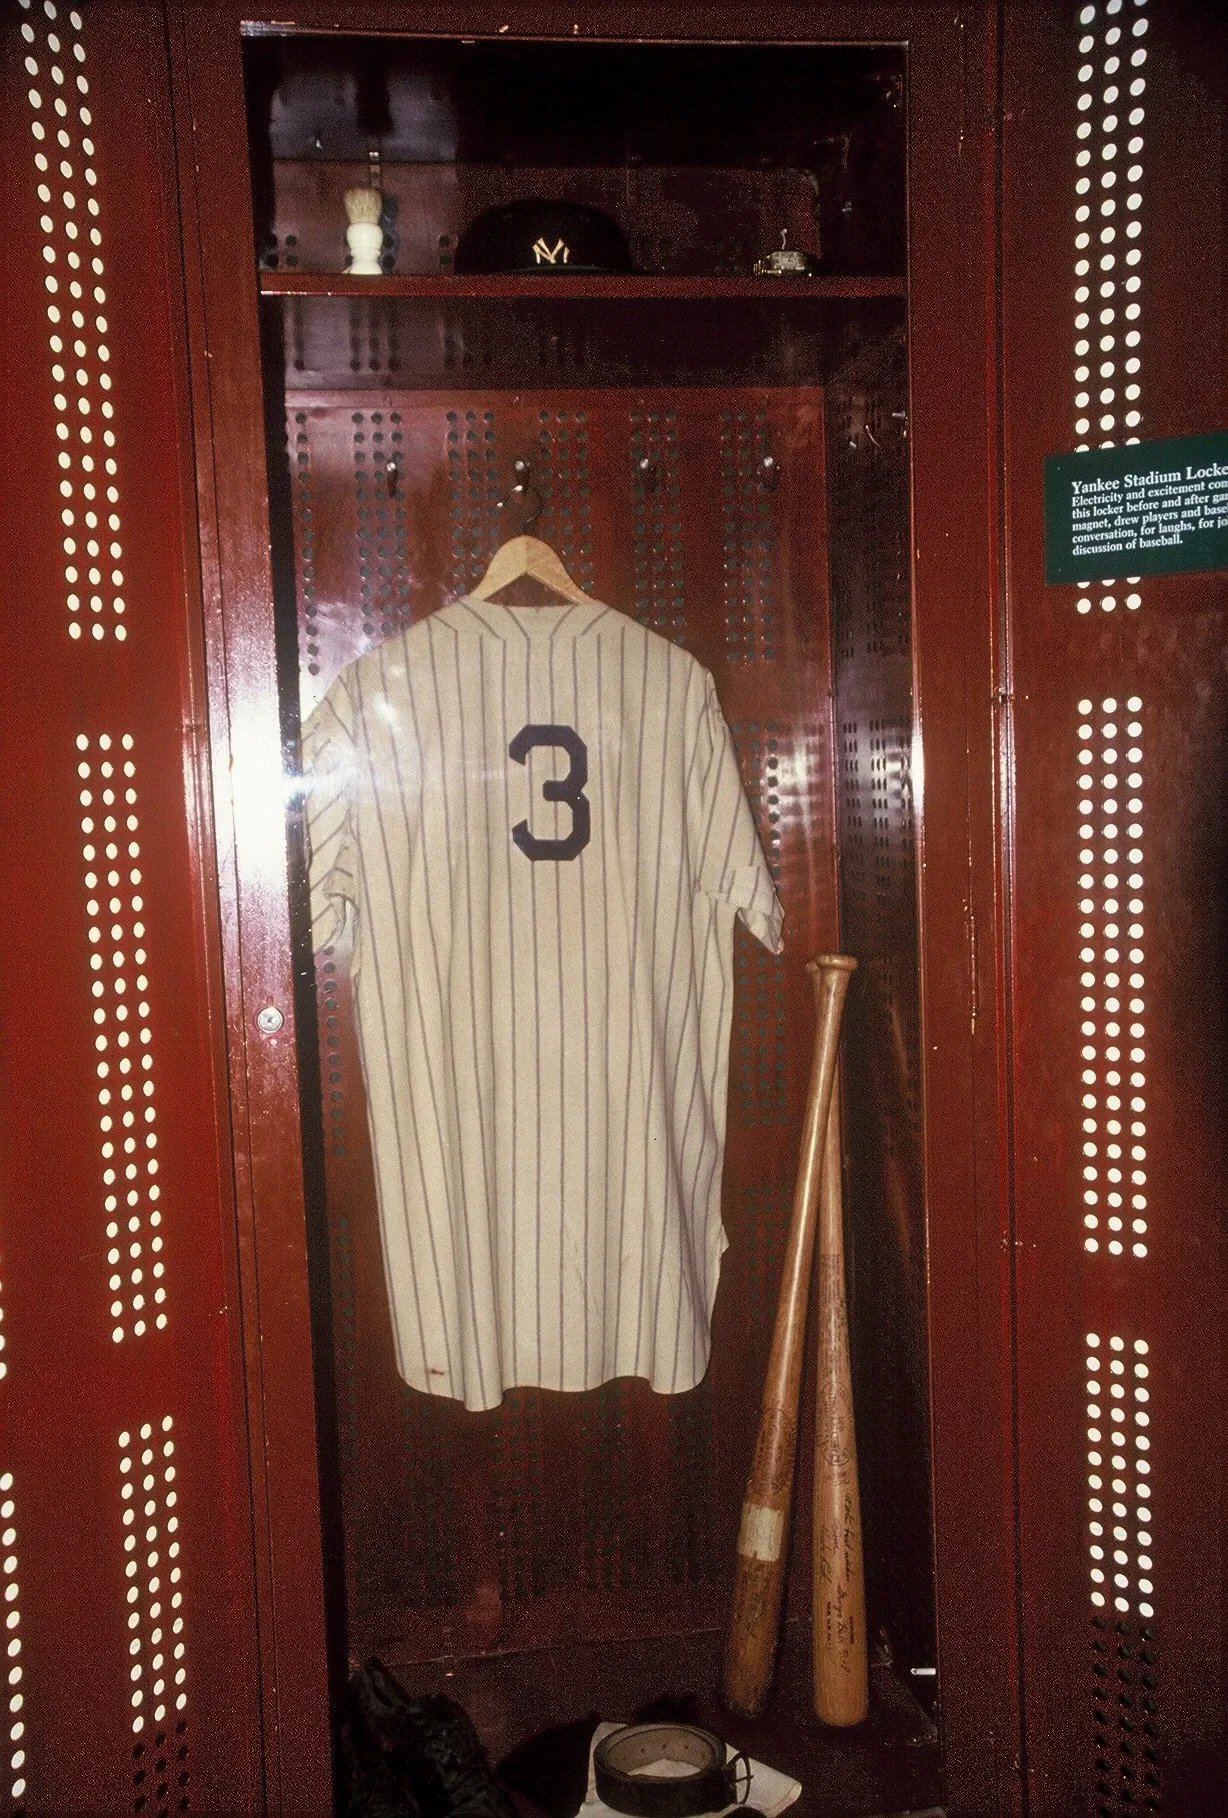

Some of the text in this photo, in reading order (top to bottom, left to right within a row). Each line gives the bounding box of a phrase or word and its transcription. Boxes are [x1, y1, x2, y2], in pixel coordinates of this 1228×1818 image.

[1071, 478, 1120, 494] Yankee
[1124, 471, 1181, 488] Stadium
[1072, 492, 1123, 507] Electricity
[1126, 488, 1145, 500] and
[1148, 481, 1206, 497] excitement
[1072, 508, 1091, 519] this
[1093, 504, 1124, 517] locker
[1126, 500, 1160, 513] before
[1162, 495, 1181, 508] and
[1184, 494, 1210, 505] after
[1072, 503, 1228, 532] magnet, drew players and base
[1072, 528, 1138, 543] conversation,
[1140, 525, 1156, 536] for
[1159, 520, 1195, 533] laughs,
[1198, 518, 1215, 529] for
[1072, 533, 1183, 556] discussion of baseball.
[508, 724, 591, 861] 3
